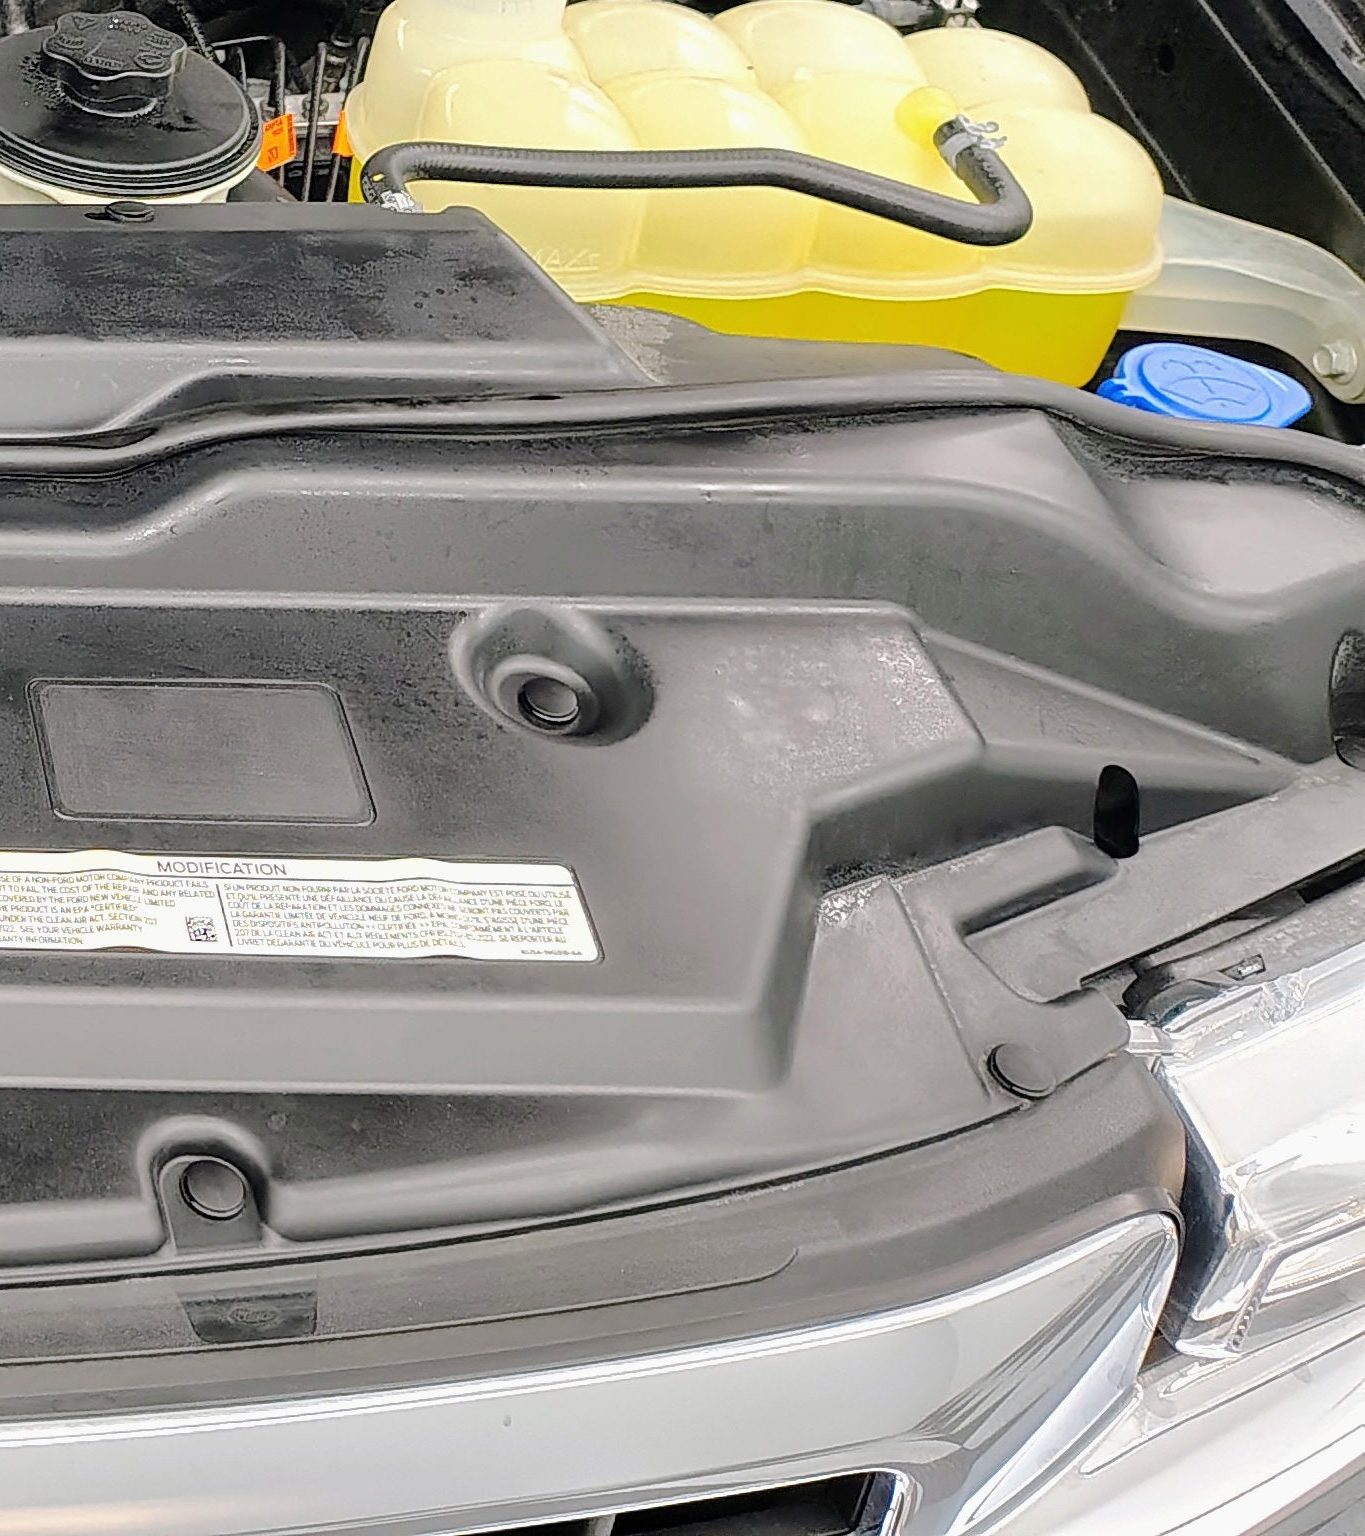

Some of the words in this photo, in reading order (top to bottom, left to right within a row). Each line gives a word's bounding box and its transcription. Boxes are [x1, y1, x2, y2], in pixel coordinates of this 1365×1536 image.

[157, 860, 287, 875] MODIFICATION
[32, 876, 74, 884] NON-FORD
[76, 874, 105, 882] MOTOR
[60, 886, 79, 894] COST
[179, 890, 214, 898] RELATED
[67, 895, 88, 903] FORD
[90, 894, 108, 902] NEW
[11, 905, 47, 913] PRODUCT
[61, 906, 71, 914] AN
[74, 905, 89, 913] EPA
[28, 915, 43, 923] THE
[45, 916, 72, 924] CLEAN
[74, 915, 87, 923] AIR
[37, 926, 59, 934] YOUR
[61, 926, 94, 934] VEHICLE
[97, 923, 142, 932] WARRANTY
